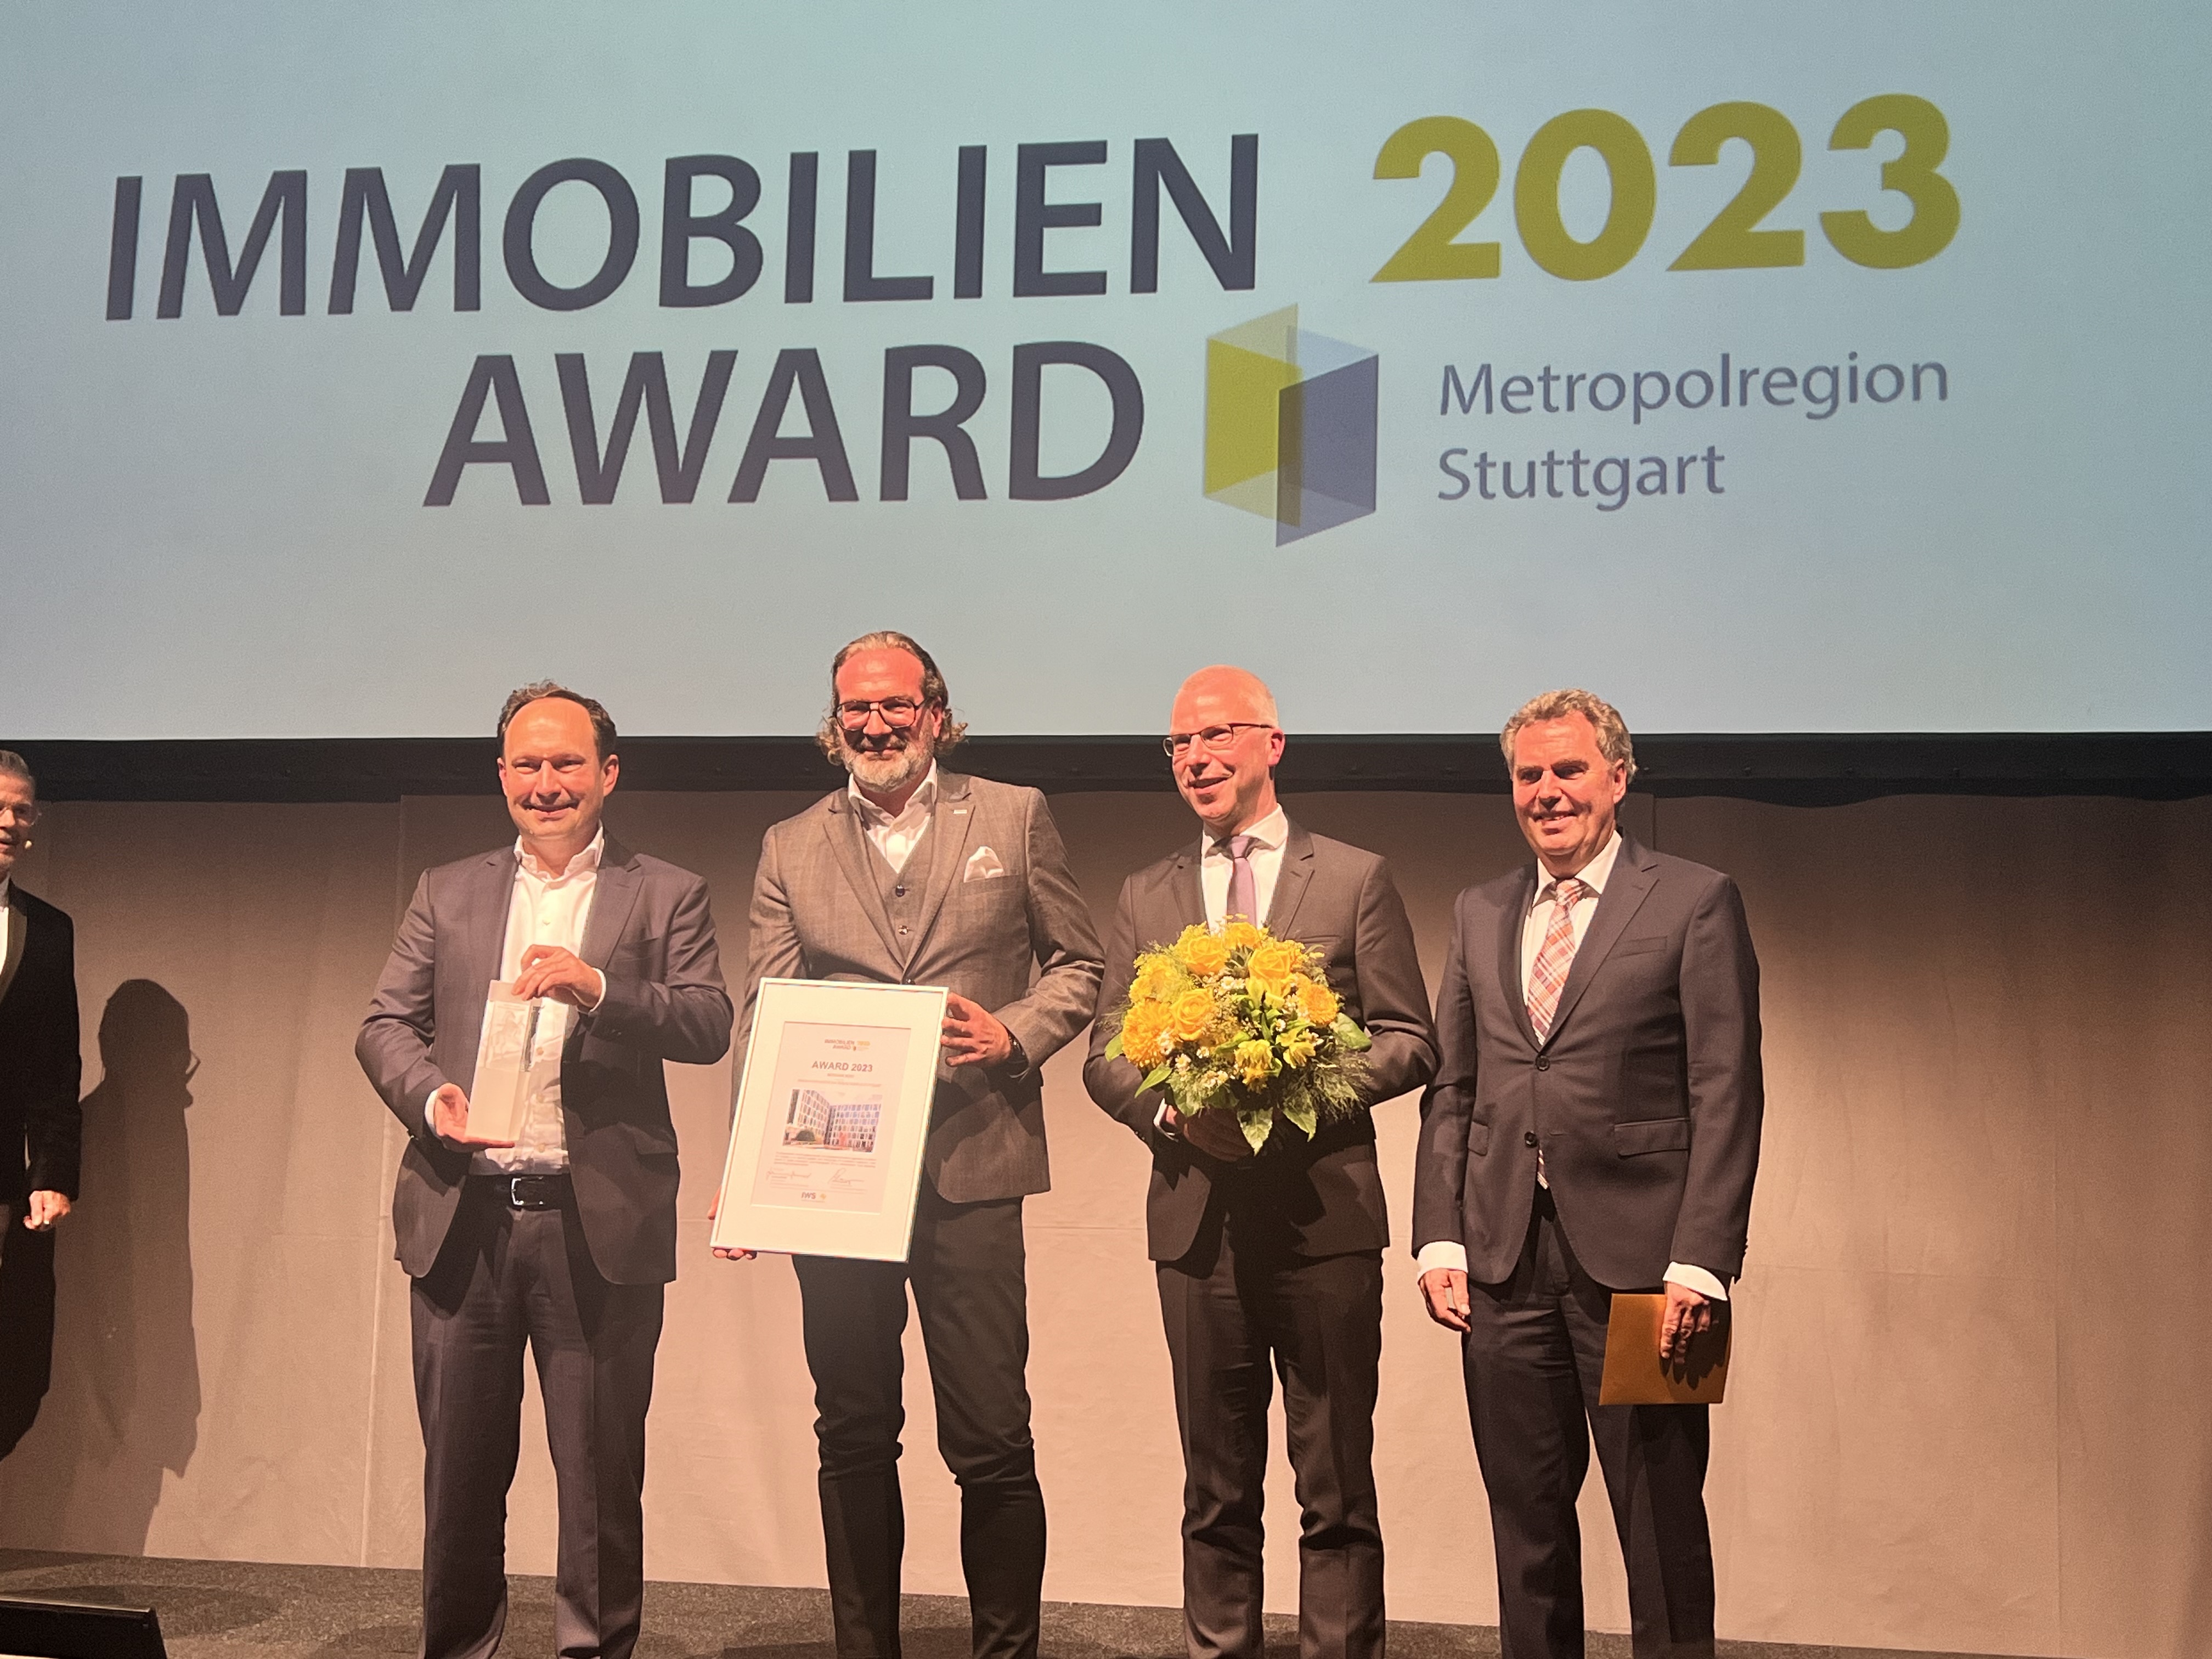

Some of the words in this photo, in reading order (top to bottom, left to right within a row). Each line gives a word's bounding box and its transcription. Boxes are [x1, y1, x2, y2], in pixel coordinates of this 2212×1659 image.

[105, 133, 1259, 321] IMMOBILIEN
[1372, 94, 1961, 283] 2023
[422, 341, 1144, 507] AWARD
[1440, 351, 1948, 424] Metropolregion
[1438, 445, 1725, 511] Stuttgart
[811, 1060, 849, 1070] AWARD
[851, 1063, 873, 1072] 2023
